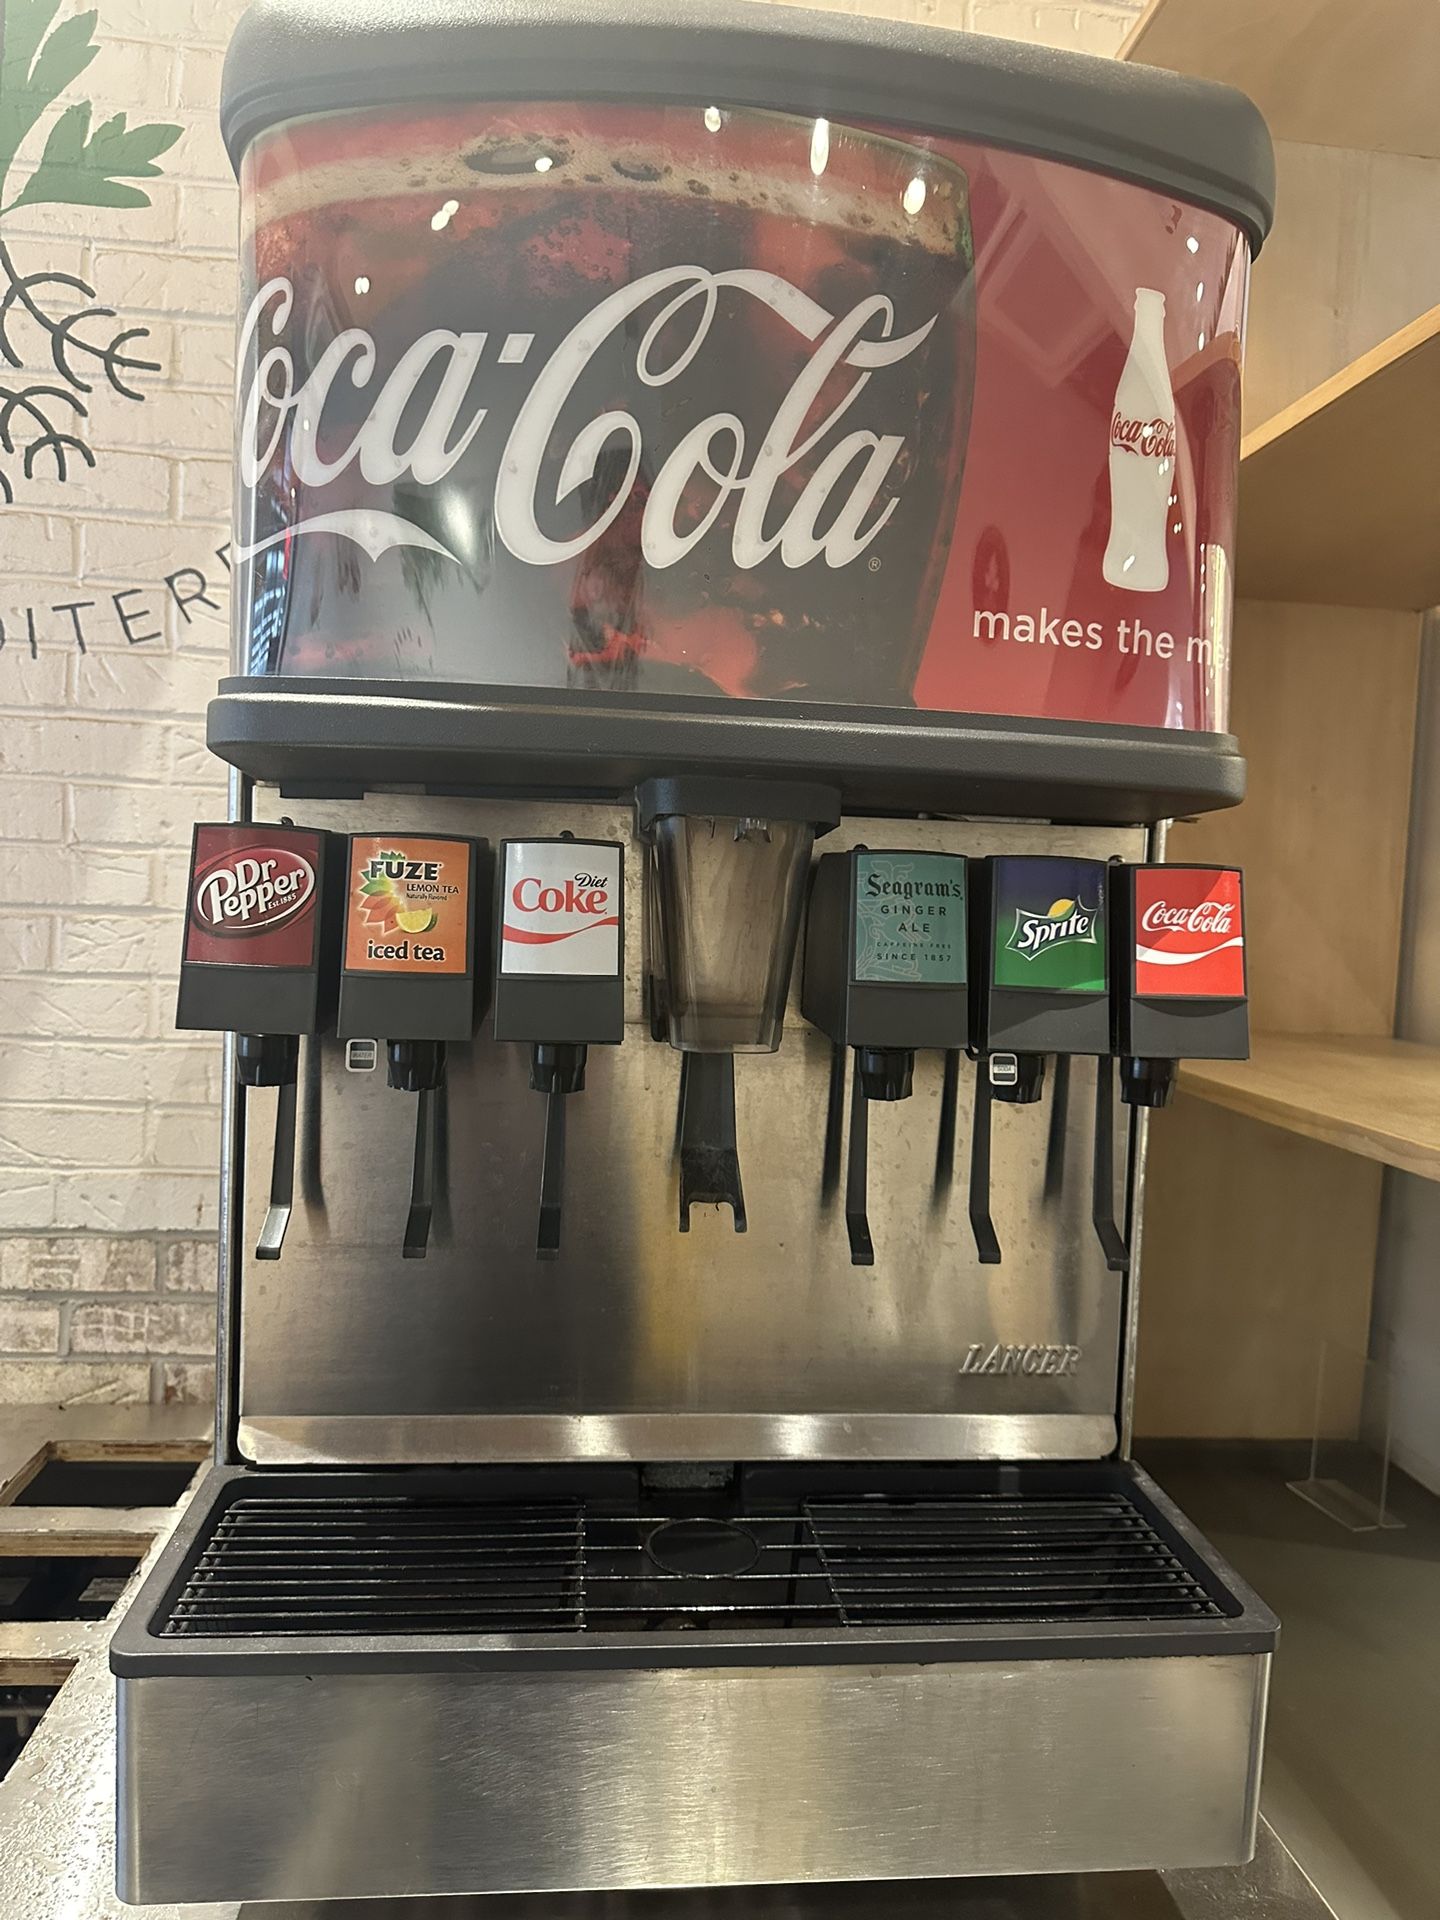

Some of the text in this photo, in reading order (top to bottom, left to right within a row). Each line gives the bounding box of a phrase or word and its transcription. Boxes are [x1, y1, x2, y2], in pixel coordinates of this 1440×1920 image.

[0, 542, 232, 660] ITER
[973, 607, 1104, 650] makes
[1117, 619, 1175, 659] the
[235, 859, 277, 892] Dr
[370, 861, 438, 880] FUZE
[574, 872, 608, 888] Diet
[197, 868, 305, 925] Pepper
[406, 883, 460, 894] LEMON TEA
[406, 893, 428, 901] Naturally
[512, 877, 608, 914] Coke
[866, 873, 962, 900] Seagram's
[880, 905, 946, 916] GINGER
[1141, 900, 1236, 934] Coca-Cola
[898, 922, 930, 933] ALE
[1017, 909, 1090, 951] Sprite
[367, 940, 445, 961] iced tea
[876, 953, 952, 962] SINCE 1857
[959, 1343, 1082, 1376] LANCER
